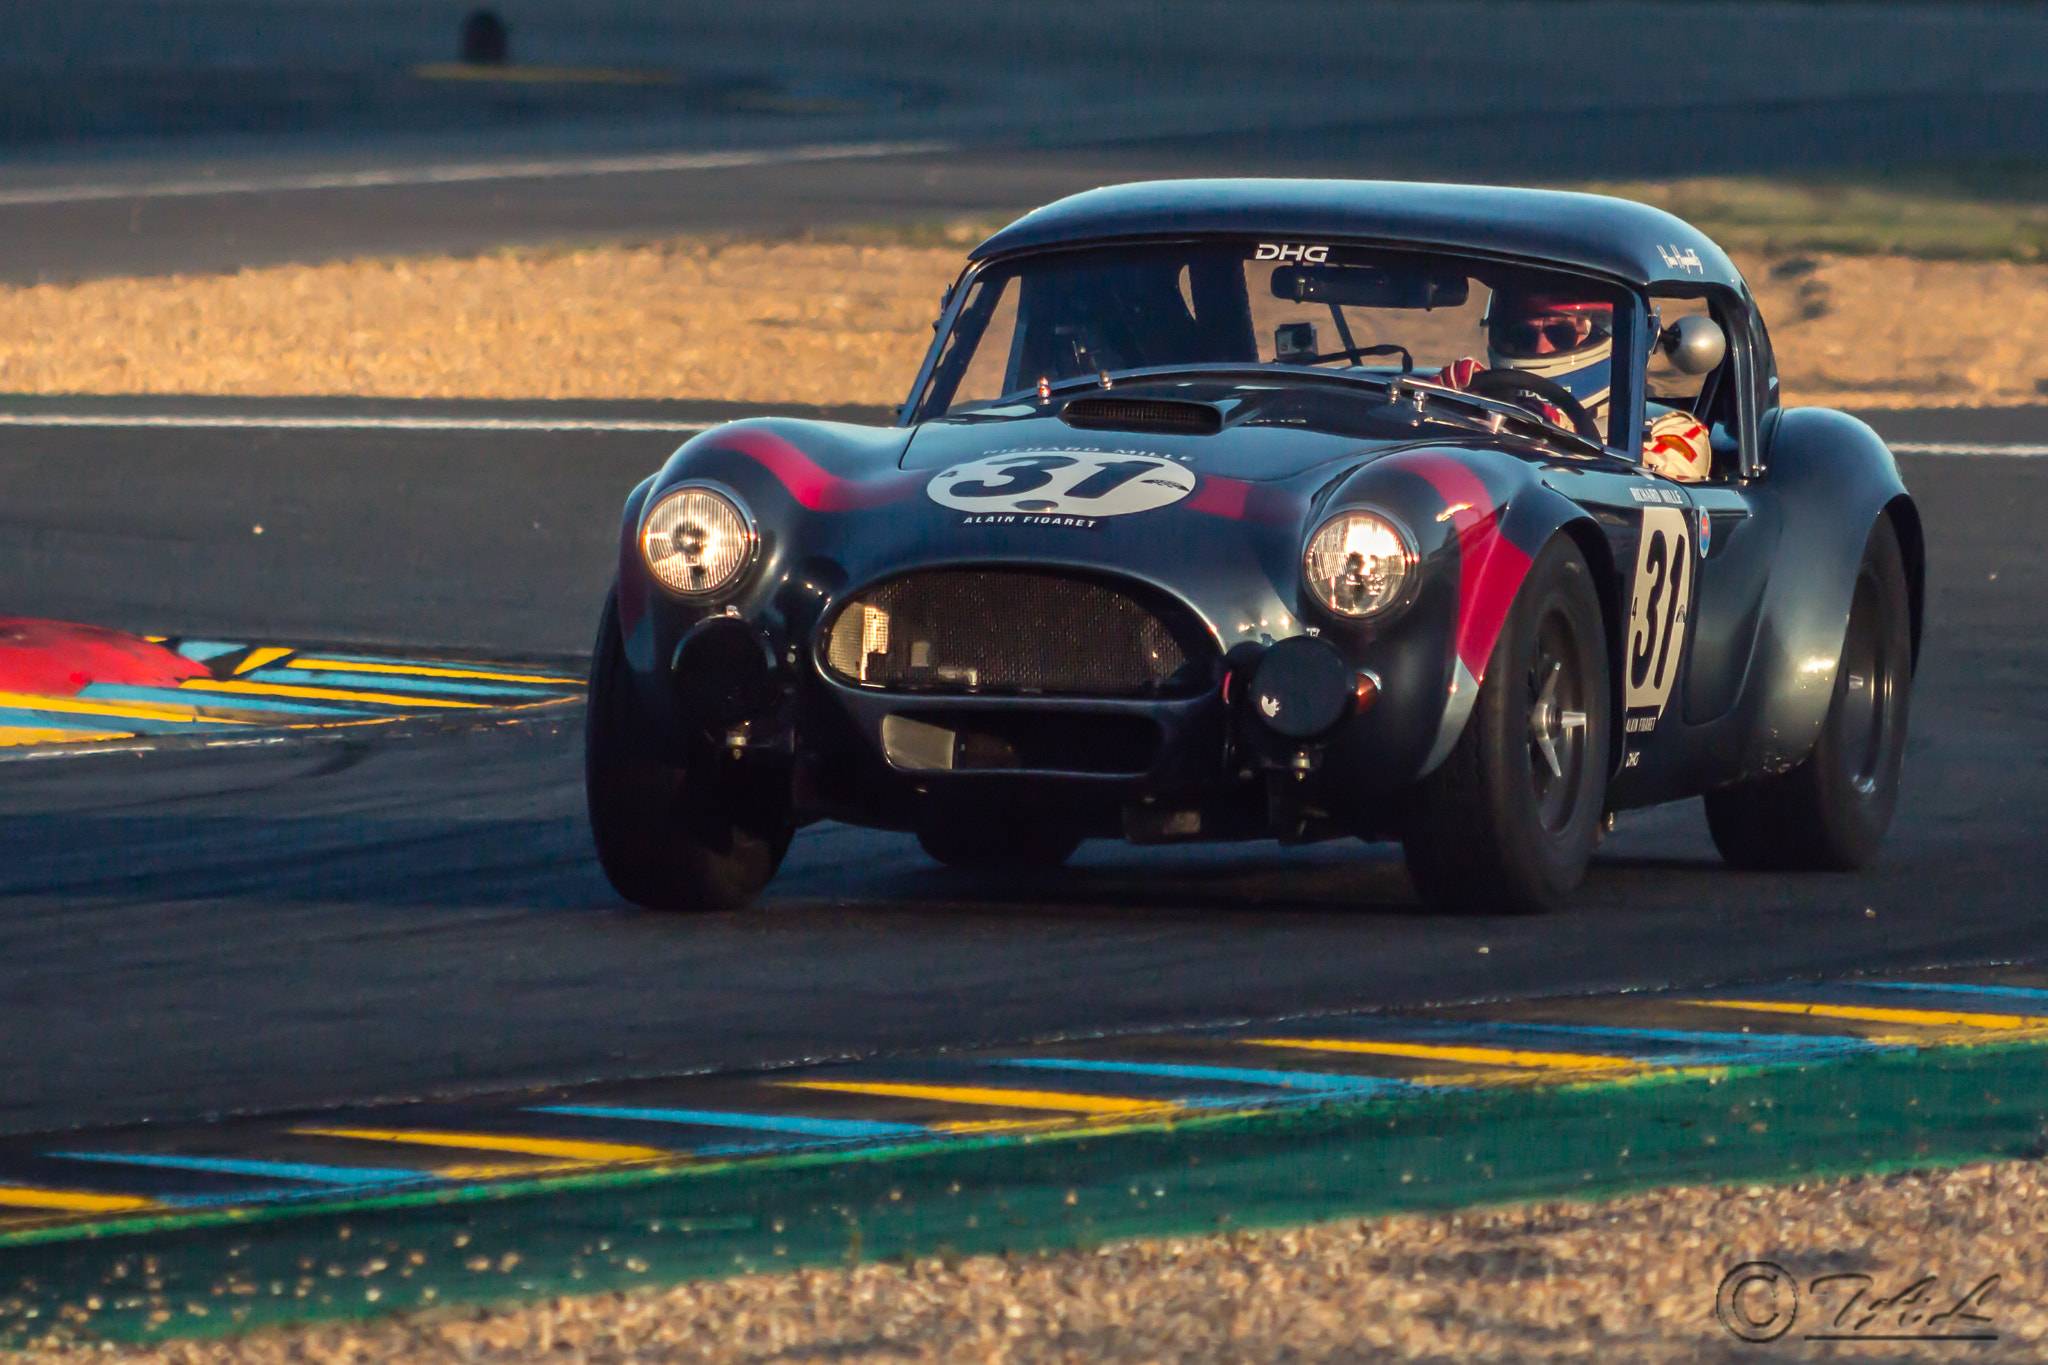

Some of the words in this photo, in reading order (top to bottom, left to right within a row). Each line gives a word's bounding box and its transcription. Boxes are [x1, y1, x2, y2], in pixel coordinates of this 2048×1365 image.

[1255, 243, 1329, 263] DHG
[949, 455, 1165, 499] 31
[963, 515, 1015, 524] ALAIN
[1631, 529, 1686, 690] 31
